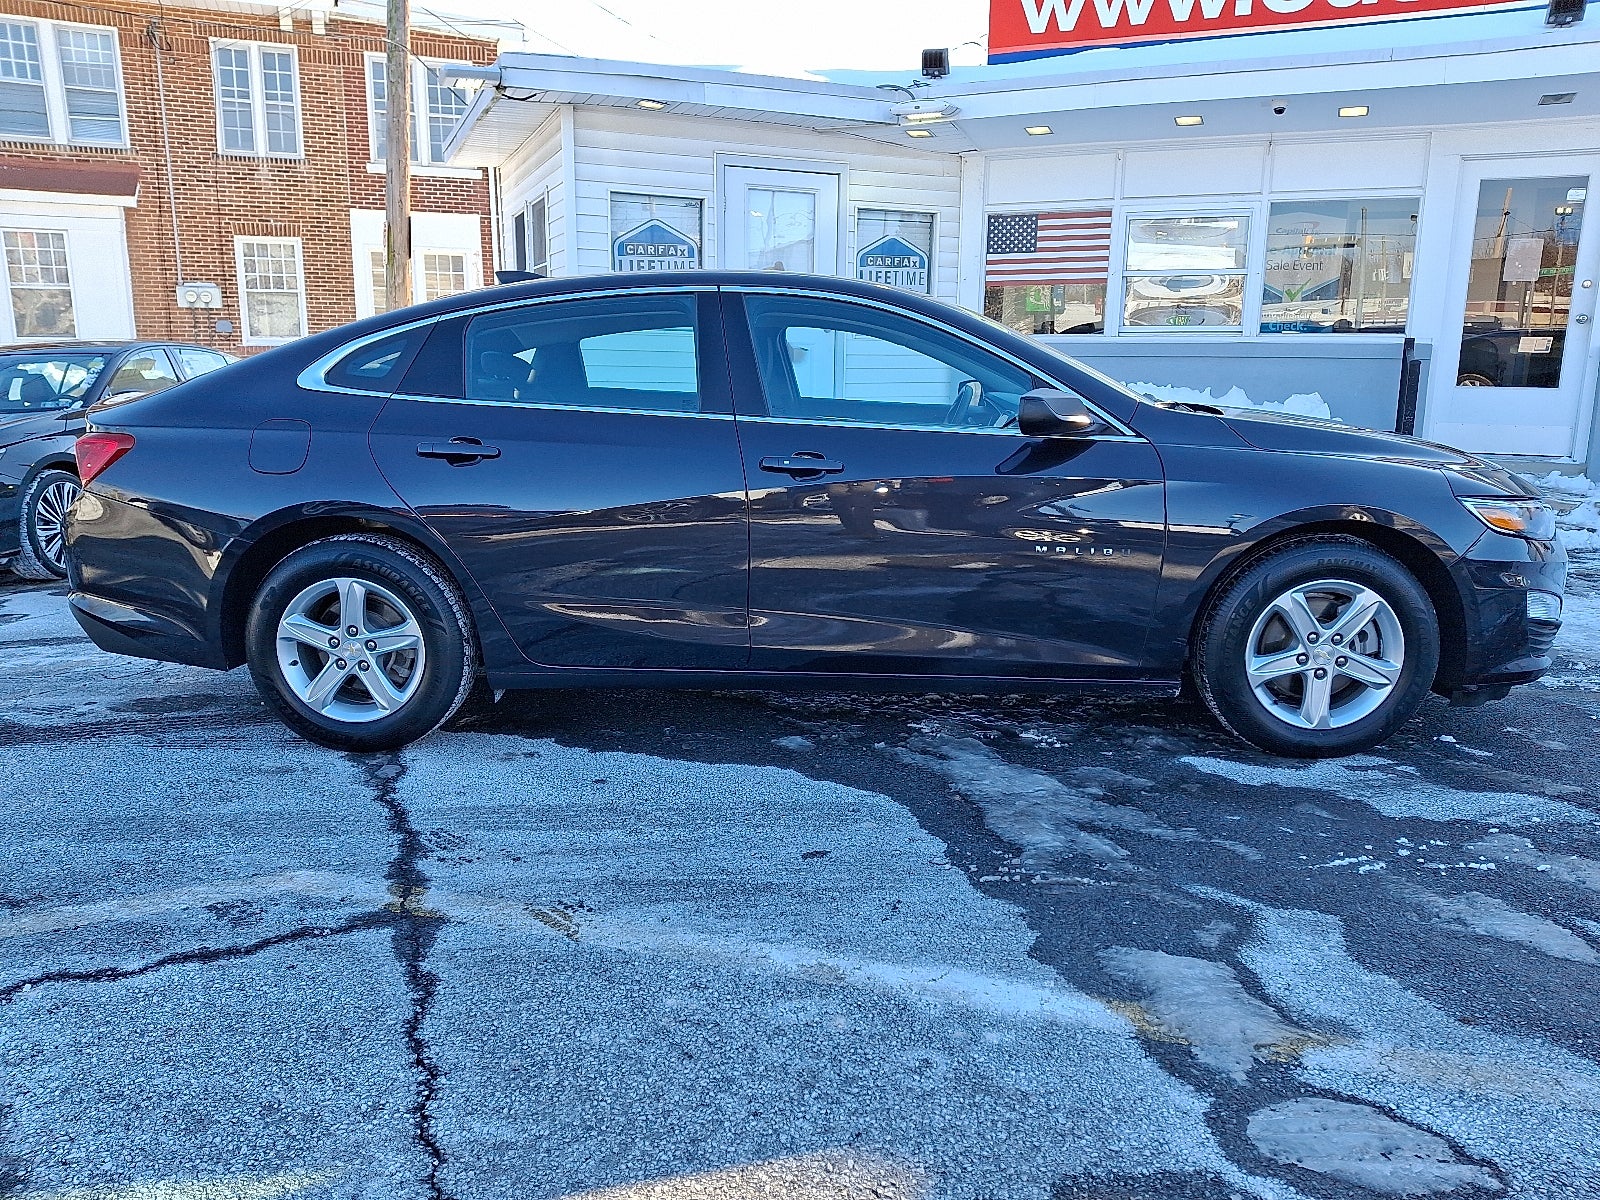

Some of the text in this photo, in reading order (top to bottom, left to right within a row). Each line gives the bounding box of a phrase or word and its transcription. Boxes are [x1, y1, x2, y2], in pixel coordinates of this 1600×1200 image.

[625, 244, 687, 257] CARFAX
[866, 256, 919, 269] CARFAX
[1265, 259, 1324, 271] Sale Event
[1035, 545, 1131, 557] MALIBU
[352, 557, 432, 612] ASSURANCE
